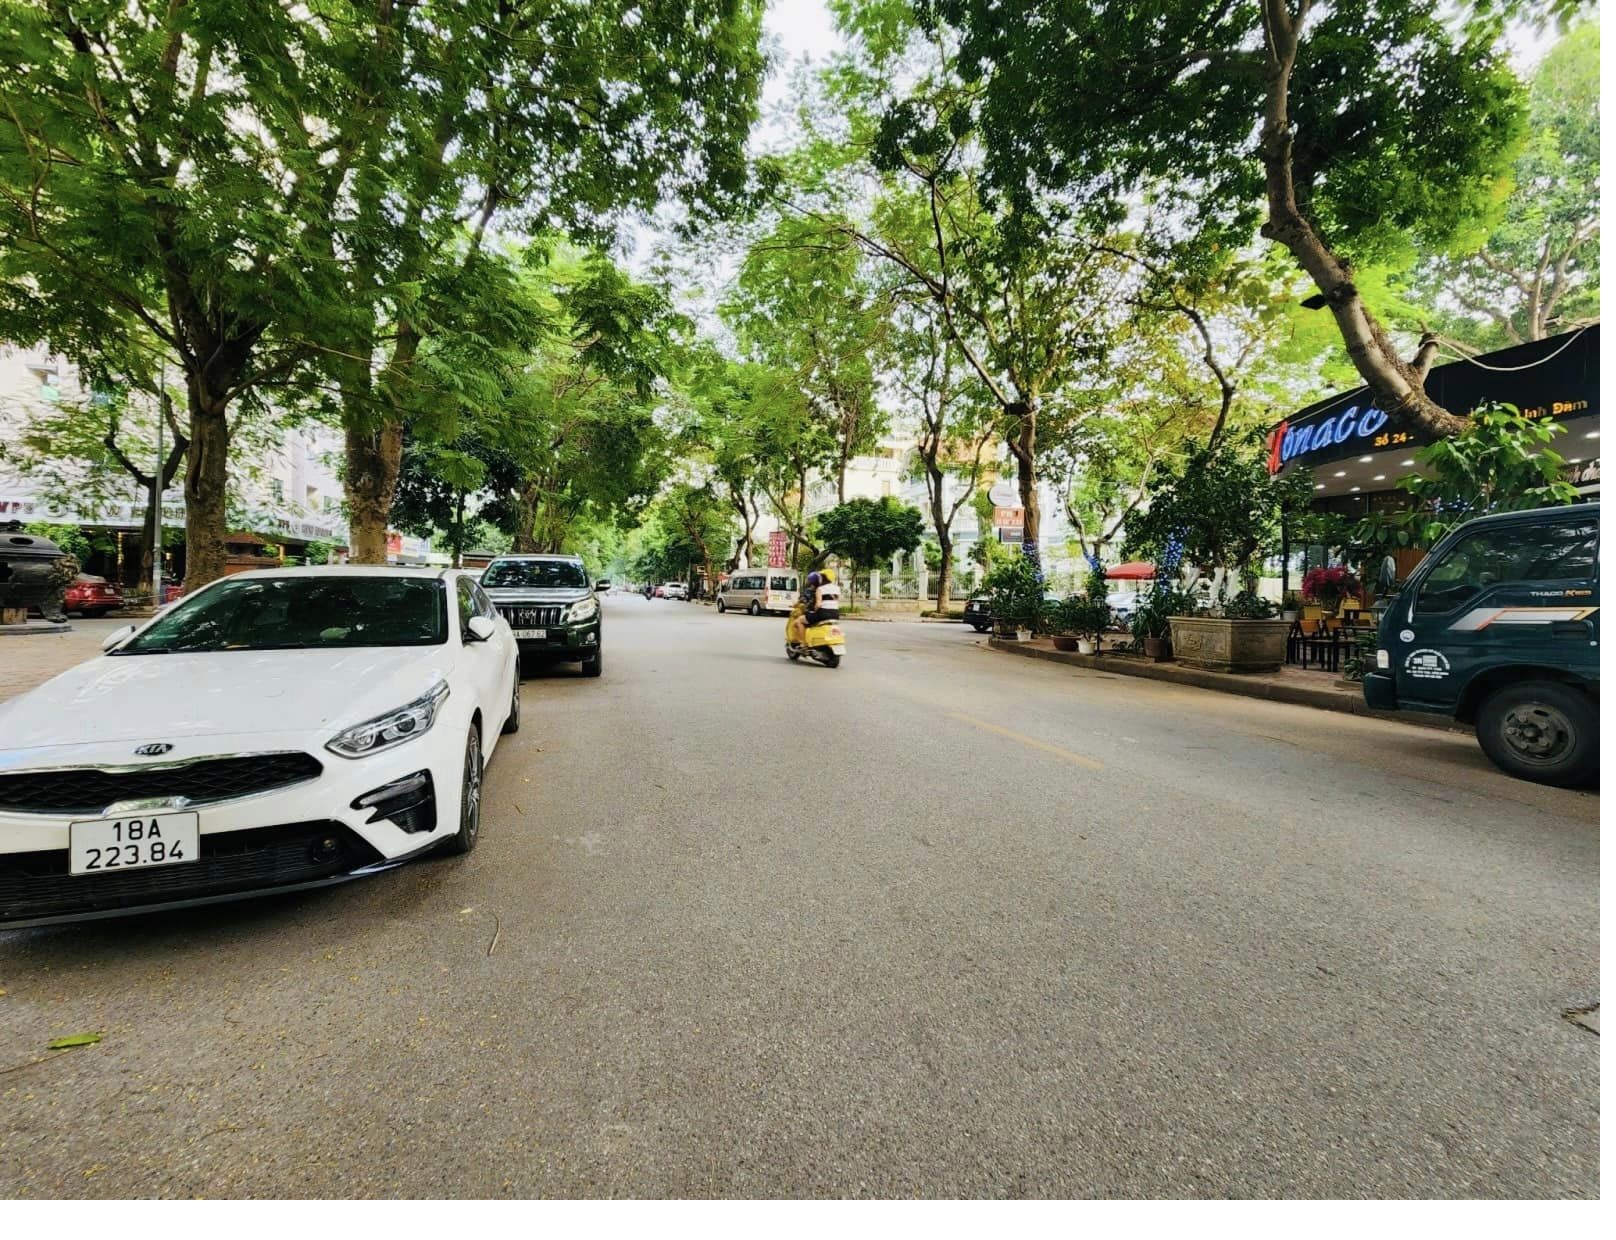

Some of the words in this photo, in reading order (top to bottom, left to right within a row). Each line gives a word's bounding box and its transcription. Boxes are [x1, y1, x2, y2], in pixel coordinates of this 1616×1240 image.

[1391, 431, 1407, 445] 24
[137, 743, 169, 756] KIA
[113, 819, 162, 843] 18A
[86, 840, 184, 870] 223.84
